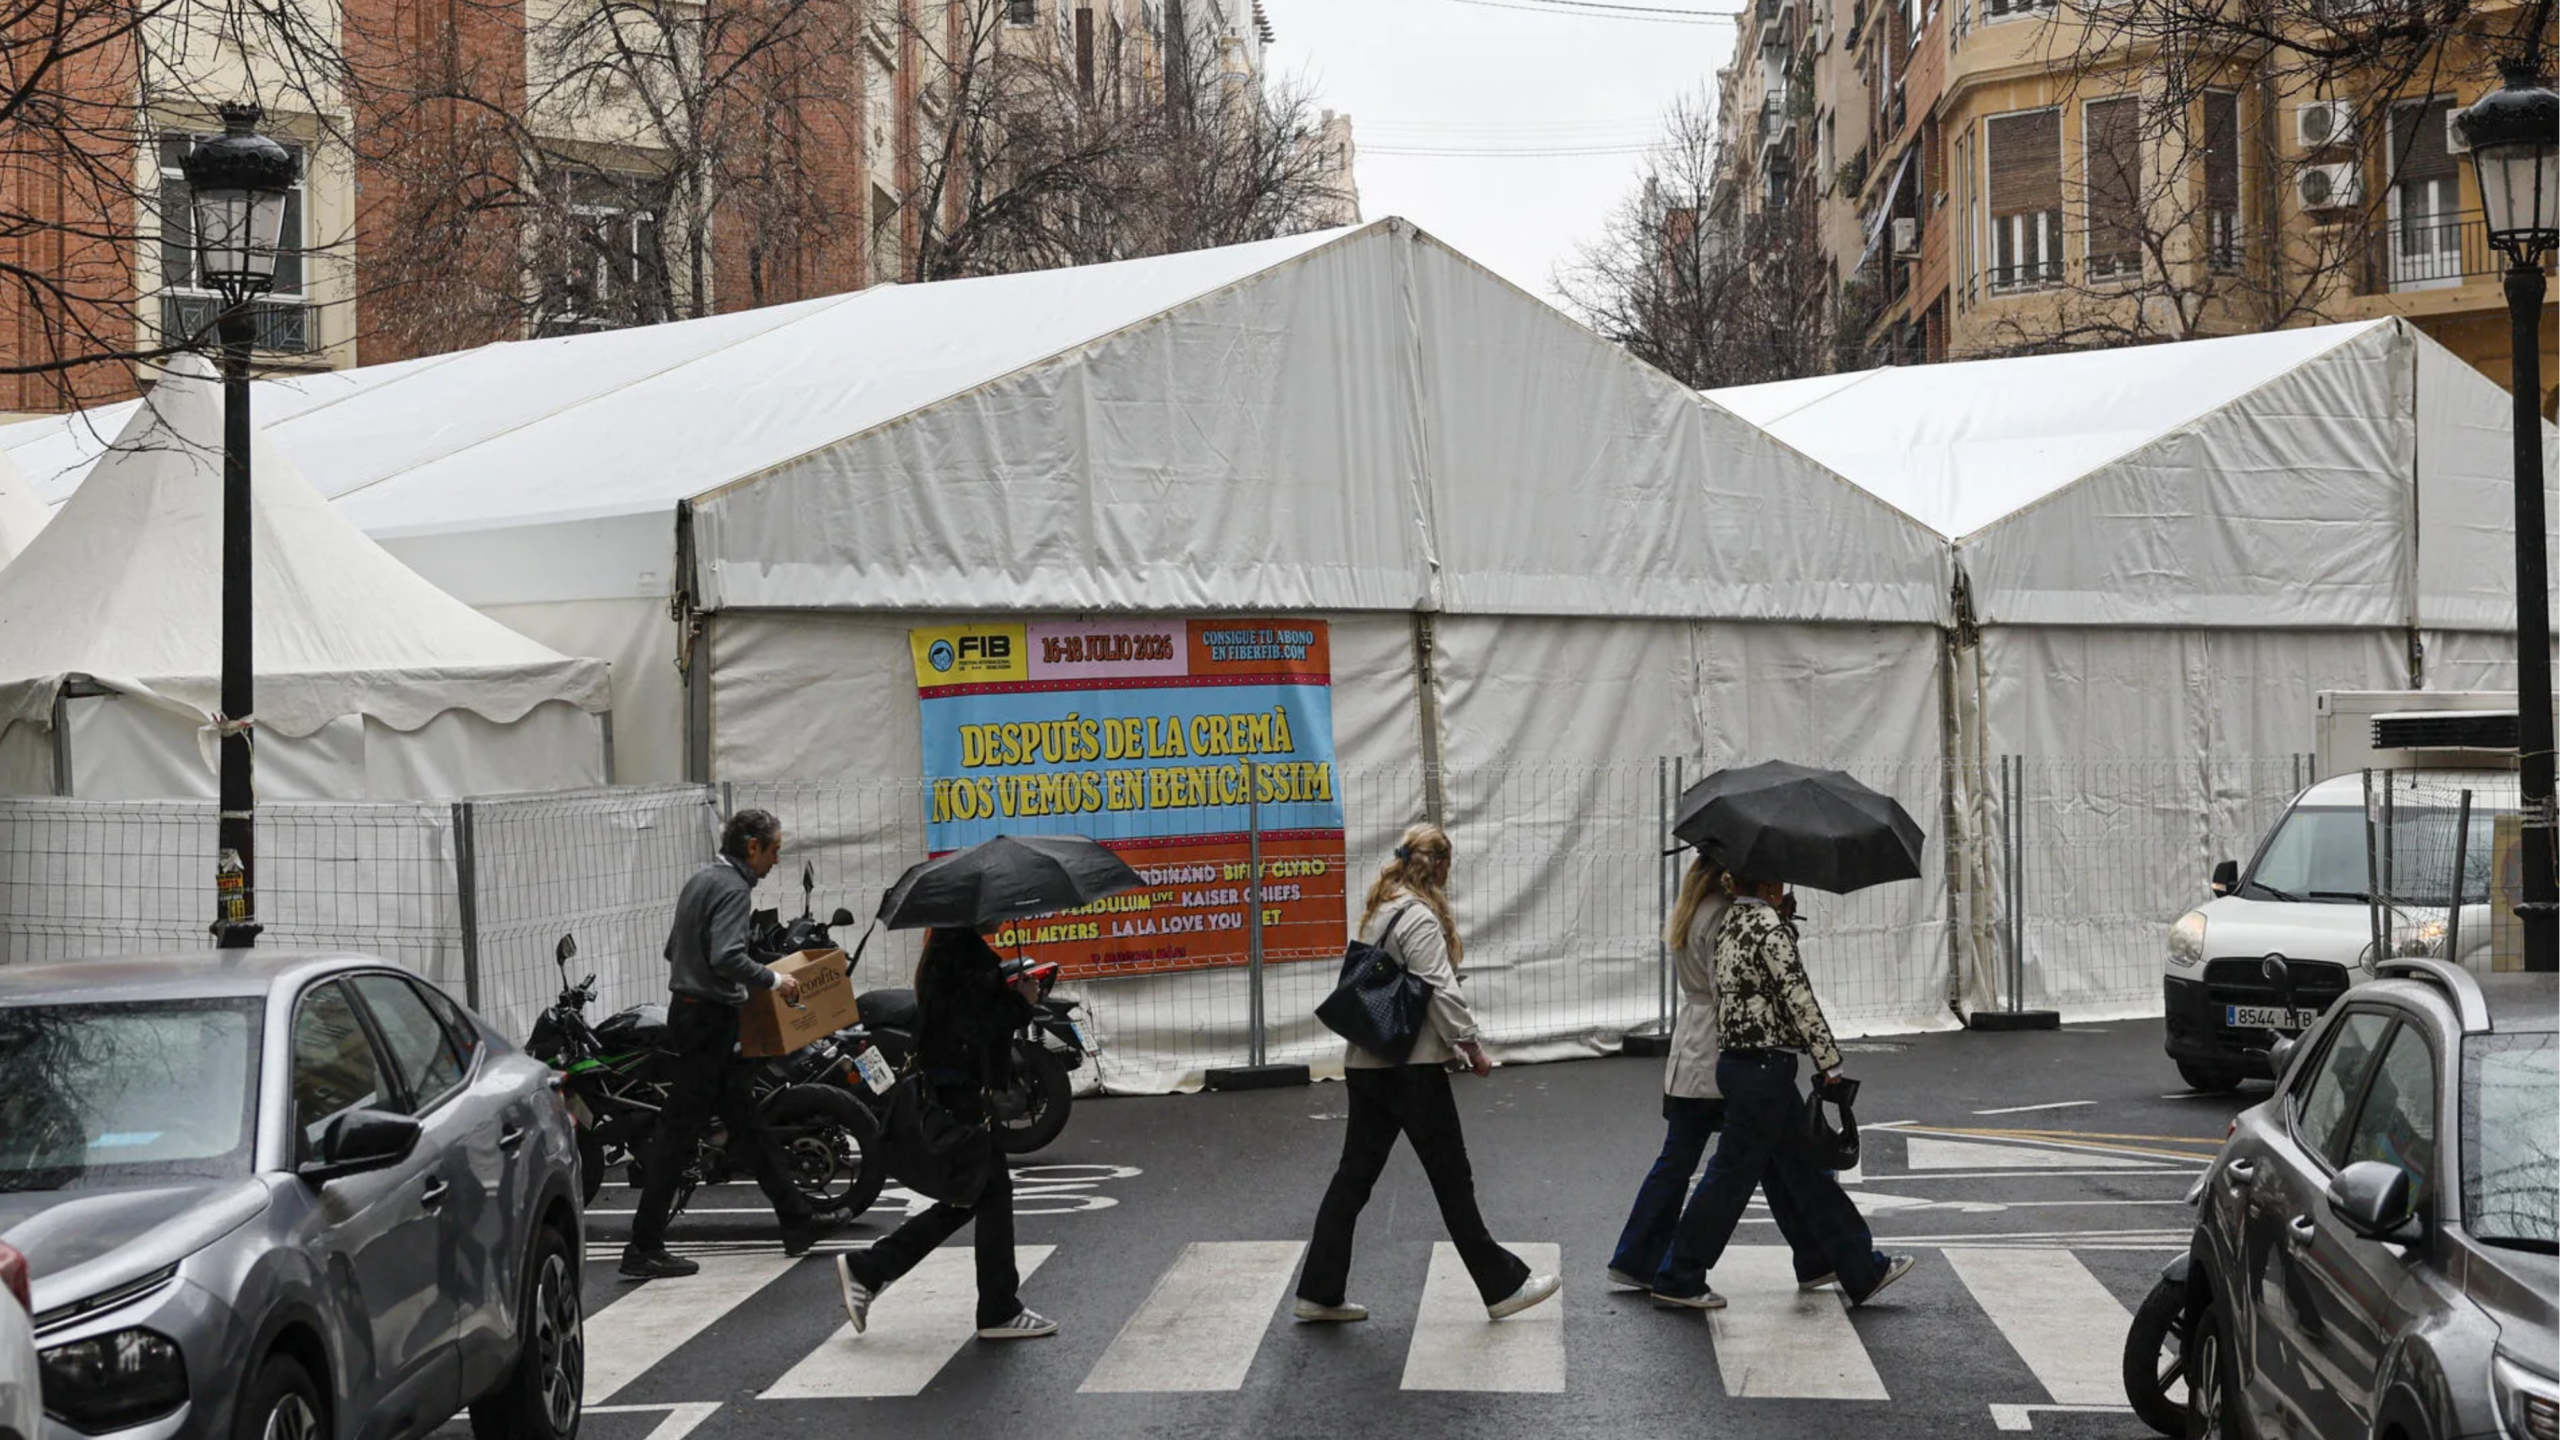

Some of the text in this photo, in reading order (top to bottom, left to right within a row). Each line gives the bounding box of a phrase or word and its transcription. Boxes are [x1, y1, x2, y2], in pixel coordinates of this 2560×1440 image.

[958, 635, 1011, 659] FIB
[1042, 634, 1173, 663] 16-18 JULIO 2026
[1203, 630, 1314, 645] CONSIGUE TU ABONO
[1212, 645, 1306, 660] EN FIBERFIB.COM
[959, 705, 1295, 767] DESPUÉS DE LA CREMÀ
[932, 757, 1333, 823] NOS VEMOS EN BENICÀSSIM
[1133, 863, 1217, 887] RDINAND
[1271, 858, 1326, 879] CLYRO
[1152, 891, 1175, 903] LIVE
[1181, 888, 1240, 908] KAISER
[994, 909, 1283, 948] LORI MEYERS LA LA LOVE YOU ET
[2238, 1008, 2275, 1025] 8544
